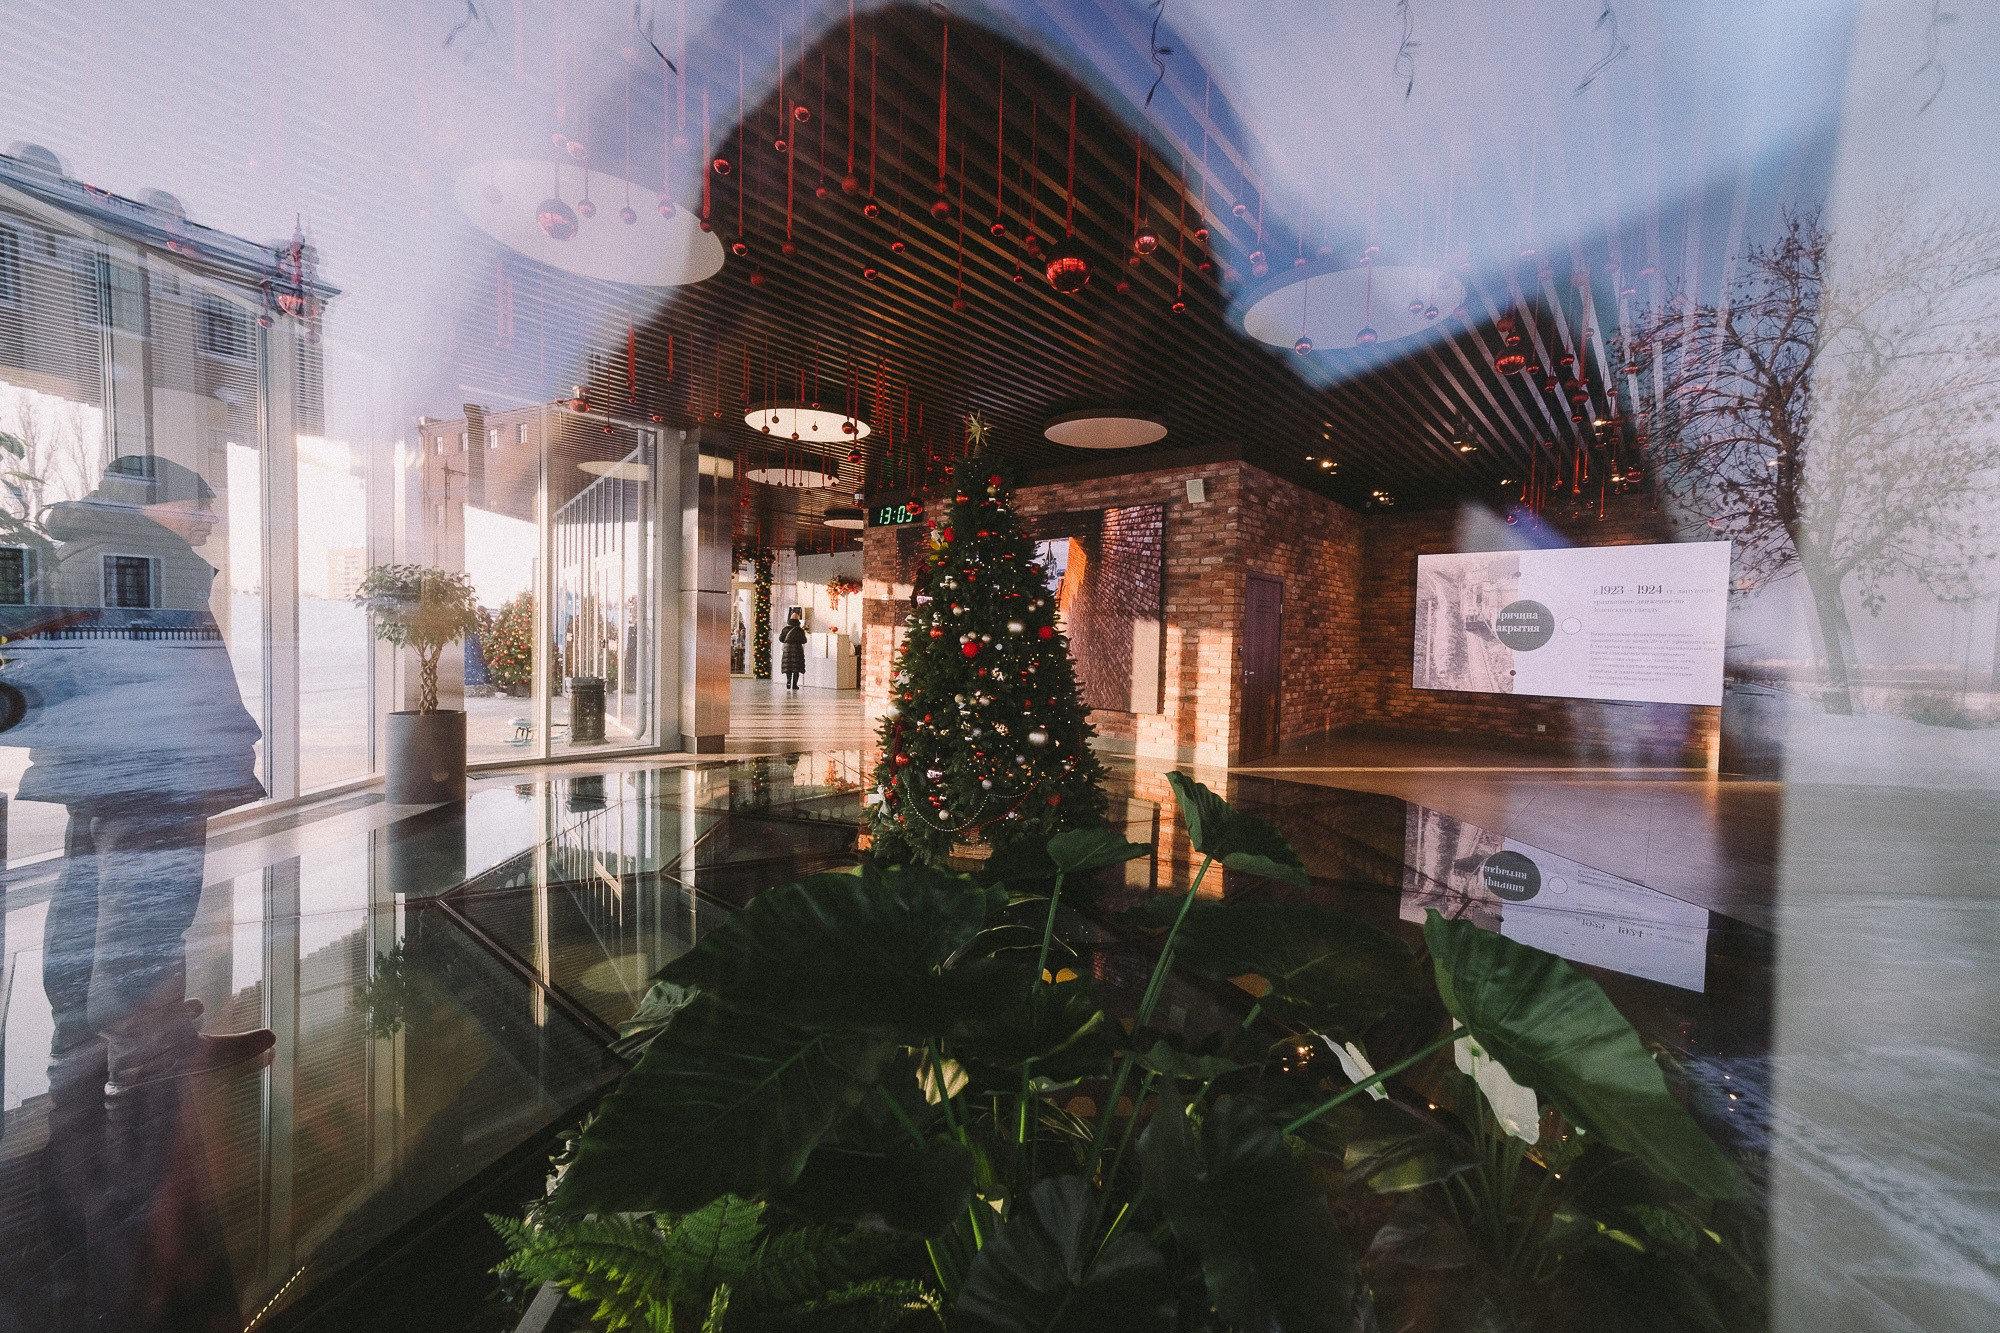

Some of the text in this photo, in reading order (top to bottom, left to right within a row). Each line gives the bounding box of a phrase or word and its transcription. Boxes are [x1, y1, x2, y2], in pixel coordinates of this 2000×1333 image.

[1600, 585, 1624, 595] 1923
[1637, 584, 1663, 595] 1924
[1496, 625, 1540, 635] акрытия
